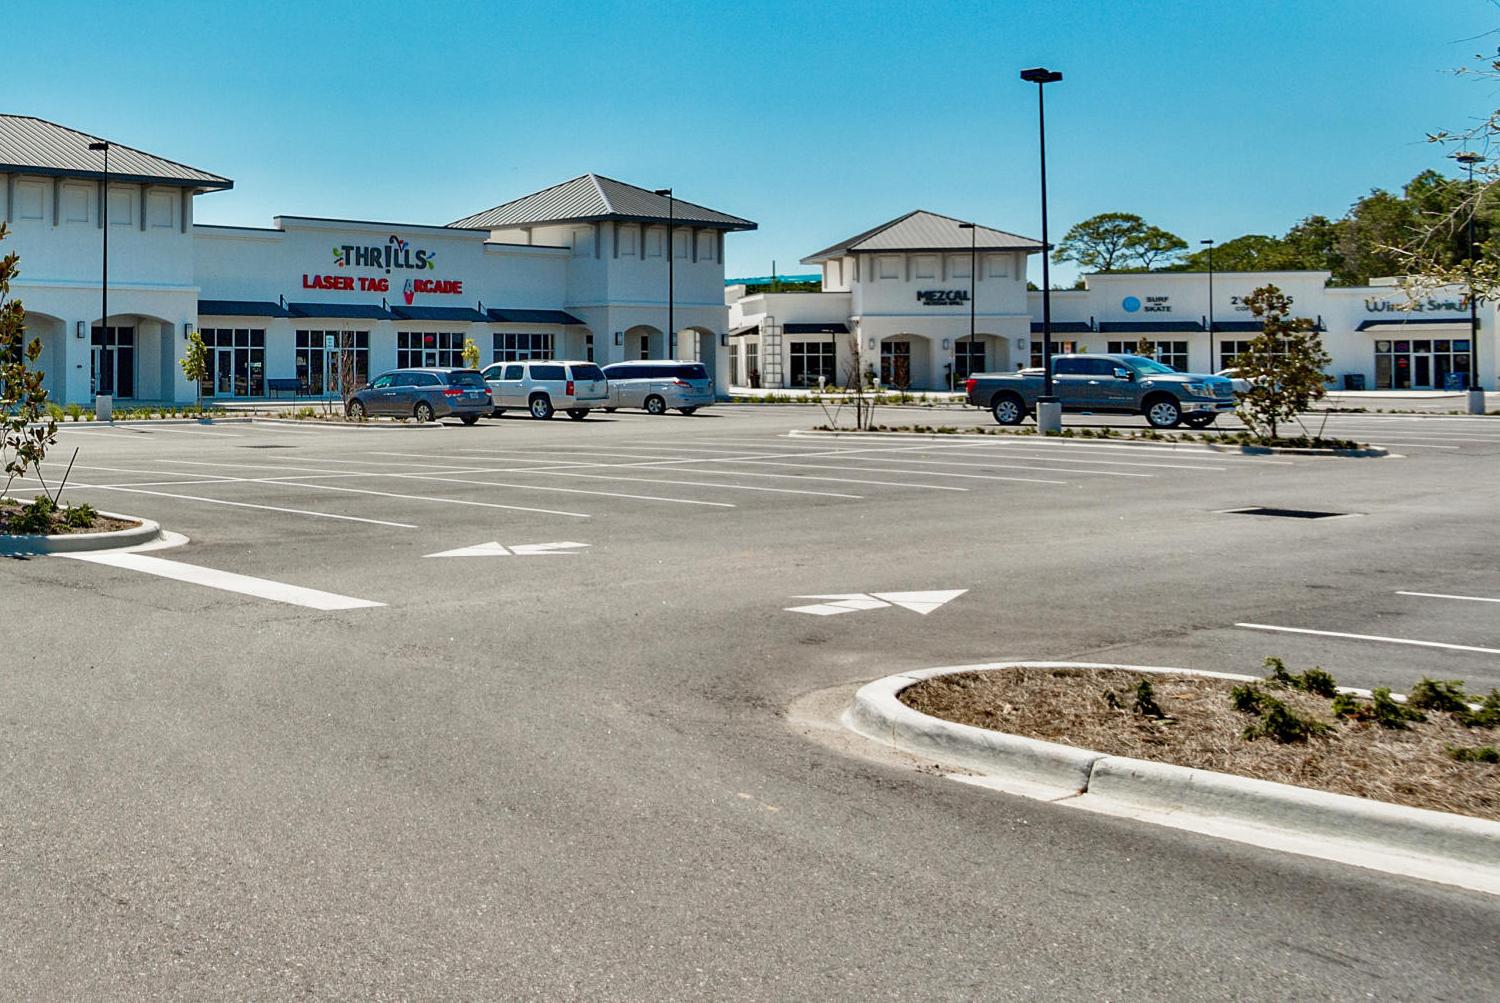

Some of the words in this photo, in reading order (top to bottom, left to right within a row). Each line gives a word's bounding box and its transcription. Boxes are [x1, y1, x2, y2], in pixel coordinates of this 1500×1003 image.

[303, 274, 355, 291] LASER
[358, 277, 389, 292] TAG
[403, 278, 463, 296] ARCADE
[916, 290, 970, 301] MEZCAL
